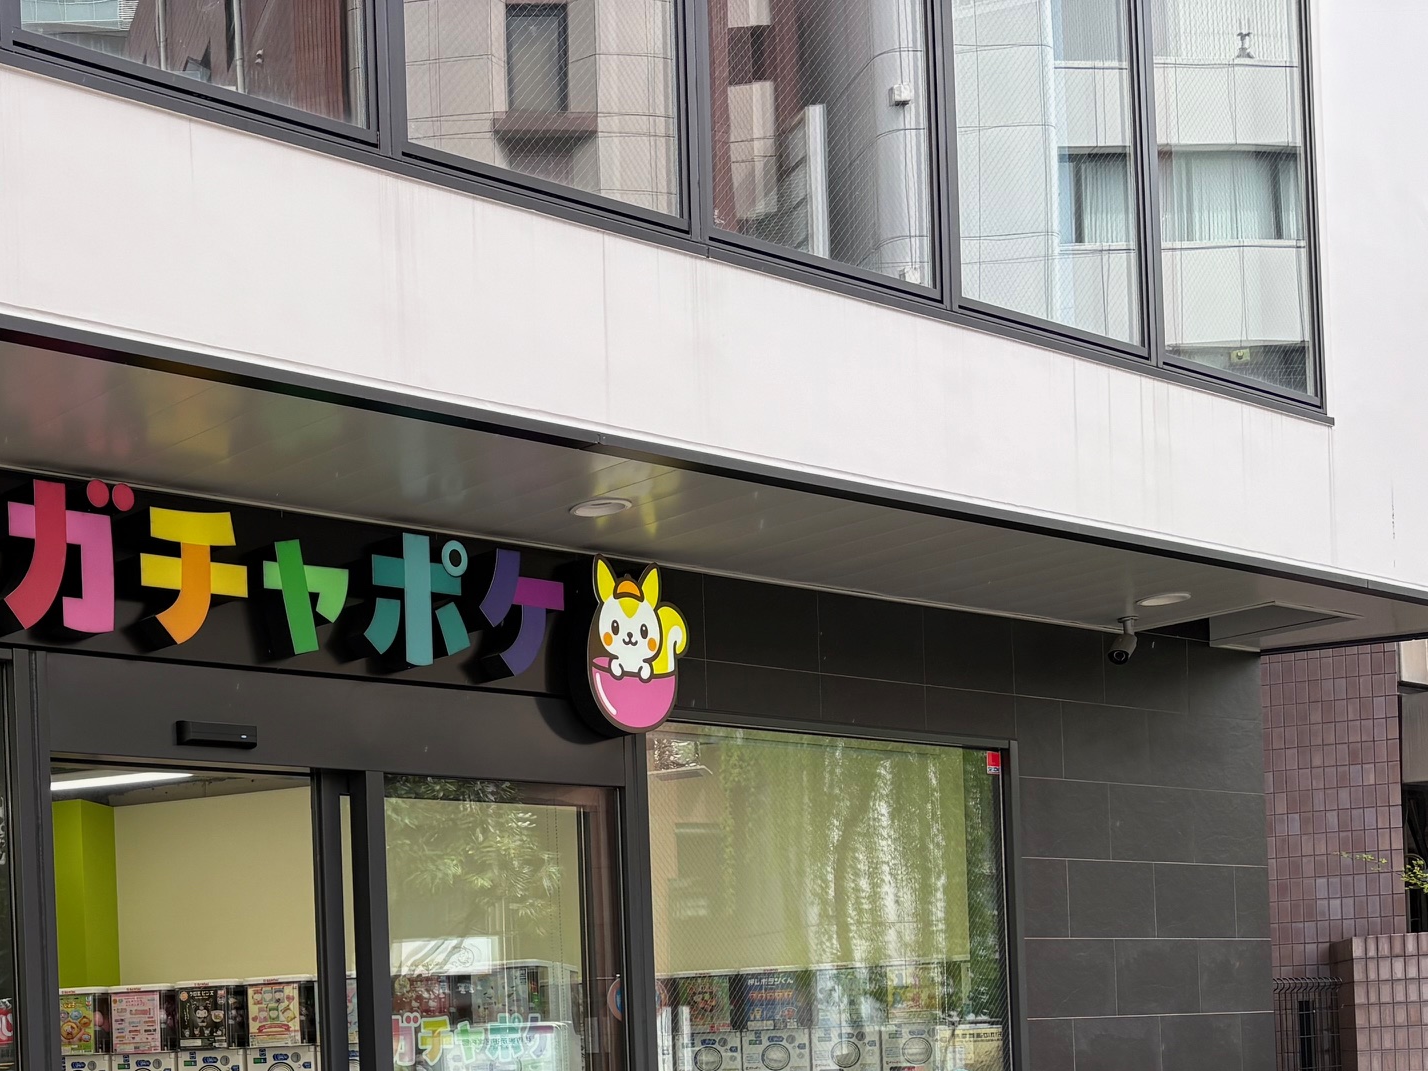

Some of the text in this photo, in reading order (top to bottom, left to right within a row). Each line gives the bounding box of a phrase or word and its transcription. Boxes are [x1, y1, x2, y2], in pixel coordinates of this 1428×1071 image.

[4, 479, 564, 677] ガチャポケ
